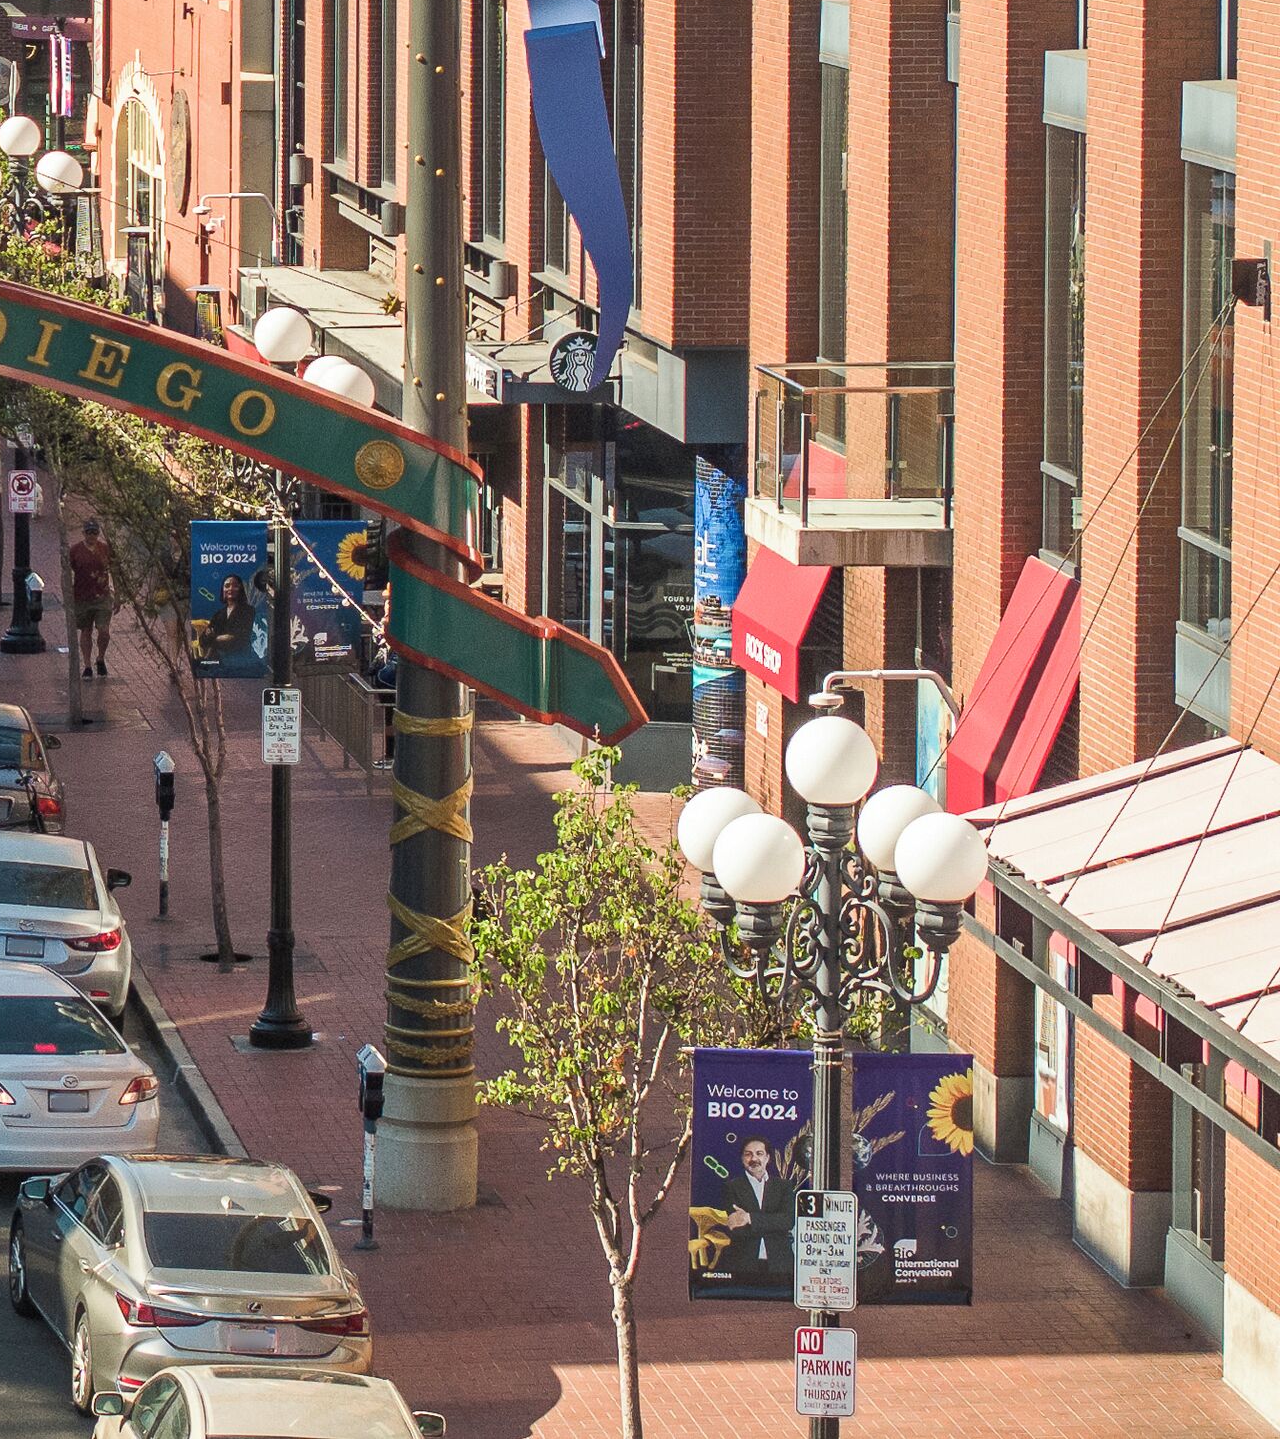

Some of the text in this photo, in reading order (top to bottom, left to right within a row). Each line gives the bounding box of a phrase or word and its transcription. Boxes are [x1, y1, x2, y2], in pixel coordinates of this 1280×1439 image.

[200, 543, 257, 553] Welcome to
[201, 554, 257, 564] BIO 2024
[745, 632, 782, 675] ROCK SHOP
[269, 691, 276, 704] 3
[707, 1084, 799, 1100] Welcome to
[708, 1102, 798, 1121] BIO 2024
[876, 1172, 959, 1181] WHERE BUSINESS
[875, 1183, 959, 1192] BREAKTHROUGHS
[881, 1194, 937, 1203] CONVERGE
[807, 1195, 853, 1215] 3 MINUTE
[806, 1221, 846, 1232] PASSENGER
[800, 1233, 852, 1245] LOADING ONLY
[895, 1259, 959, 1268] International
[895, 1269, 952, 1277] Convention
[809, 1277, 842, 1285] VIOLATORS
[830, 1286, 849, 1294] TOWED
[800, 1331, 821, 1351] NO
[801, 1359, 852, 1377] PARKING
[804, 1389, 848, 1401] THURSDAY
